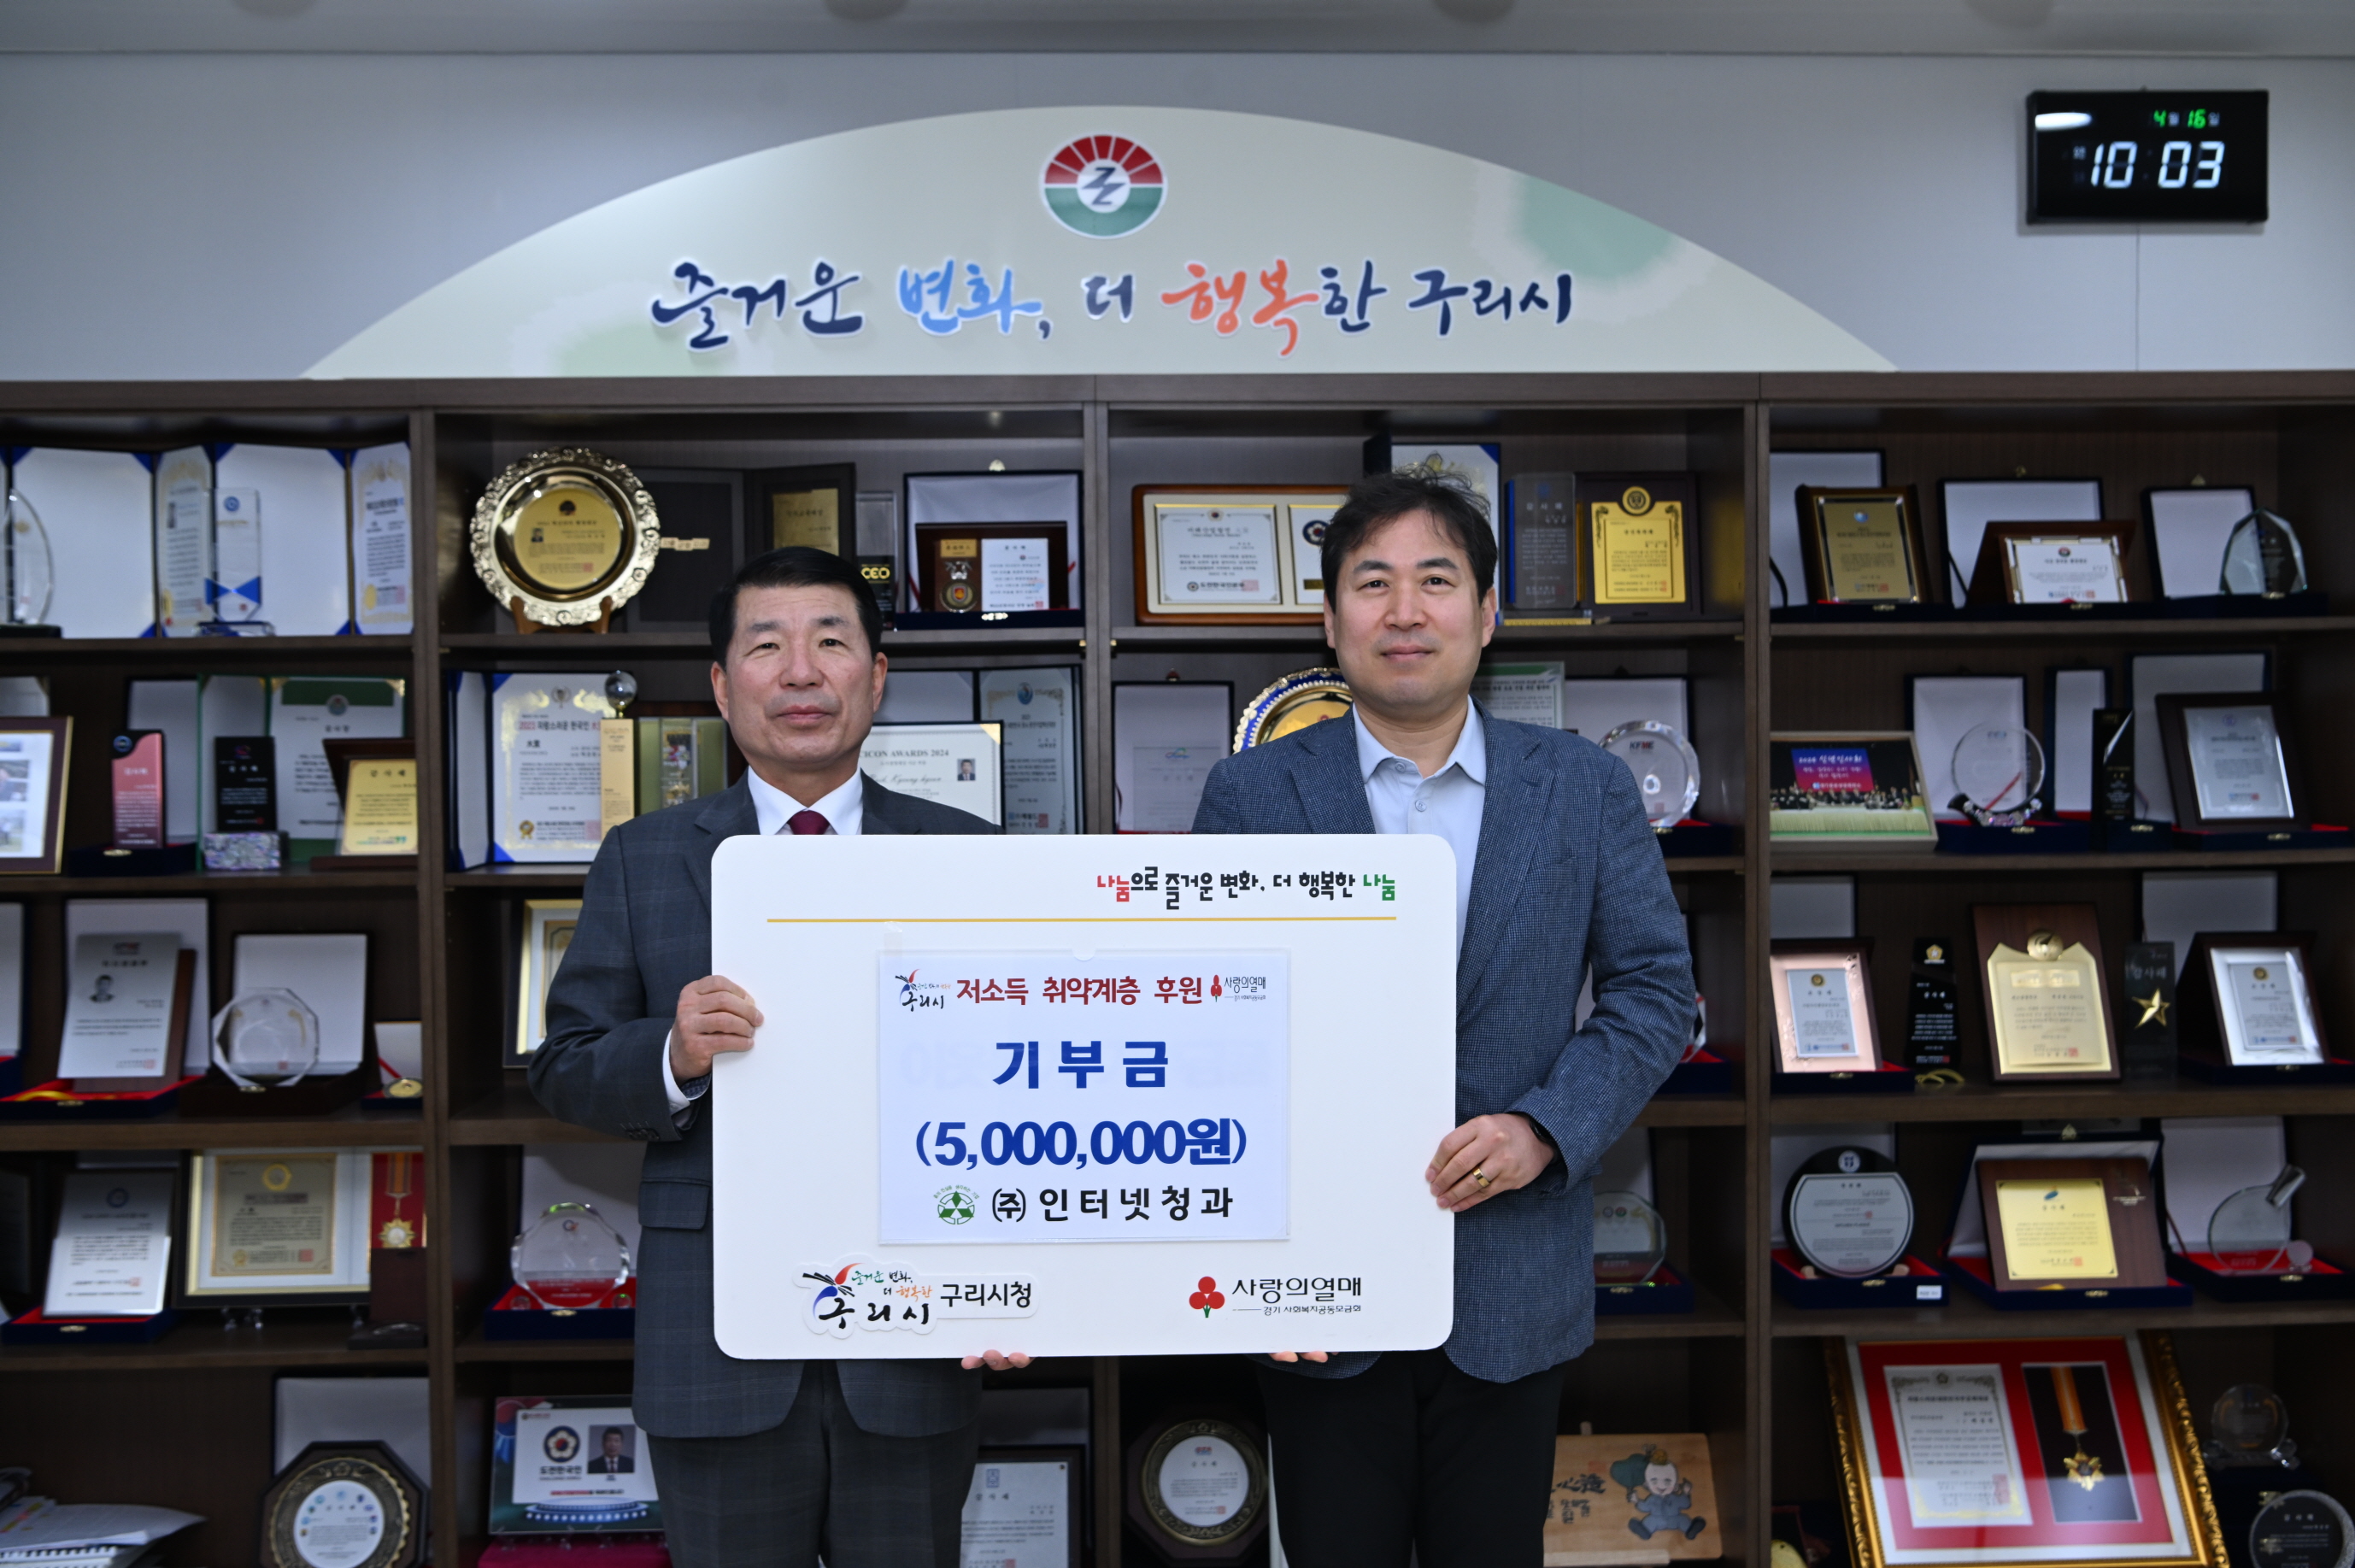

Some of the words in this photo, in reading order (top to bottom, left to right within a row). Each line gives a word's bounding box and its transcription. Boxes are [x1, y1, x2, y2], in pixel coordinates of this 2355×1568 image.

[2090, 141, 2138, 189] 10
[2157, 141, 2225, 189] 03
[652, 261, 863, 349] 즐거운
[899, 261, 1052, 340] 변화,
[1085, 273, 1136, 320] 더
[1161, 259, 1386, 356] 행복한
[1409, 268, 1573, 336] 구리시
[891, 749, 929, 758] AWARDS
[1097, 866, 1159, 902] 나눔으로
[1165, 872, 1213, 910] 즐거운
[1273, 874, 1291, 887] 더
[1299, 871, 1356, 901] 행복한
[1363, 873, 1395, 901] 나눔
[956, 978, 1029, 1005] 저소득
[1042, 976, 1141, 1006] 취약계층
[1154, 976, 1202, 1004] 후원
[1224, 976, 1266, 994] 사랑의열매
[902, 991, 945, 1012] 구리시
[992, 1041, 1168, 1089] 기부금
[916, 1118, 1247, 1171] (5,000,000원)
[1039, 1185, 1233, 1222] 인터넷청과
[852, 1270, 884, 1285] 즐거운
[1232, 1277, 1361, 1304] 사랑의열매
[883, 1287, 892, 1295] 더
[896, 1285, 933, 1302] 행복한
[940, 1281, 1031, 1308] 구리시청
[819, 1297, 930, 1330] 구리시
[1263, 1306, 1281, 1316] 경기
[1283, 1304, 1361, 1316] 사회복지공동모금회
